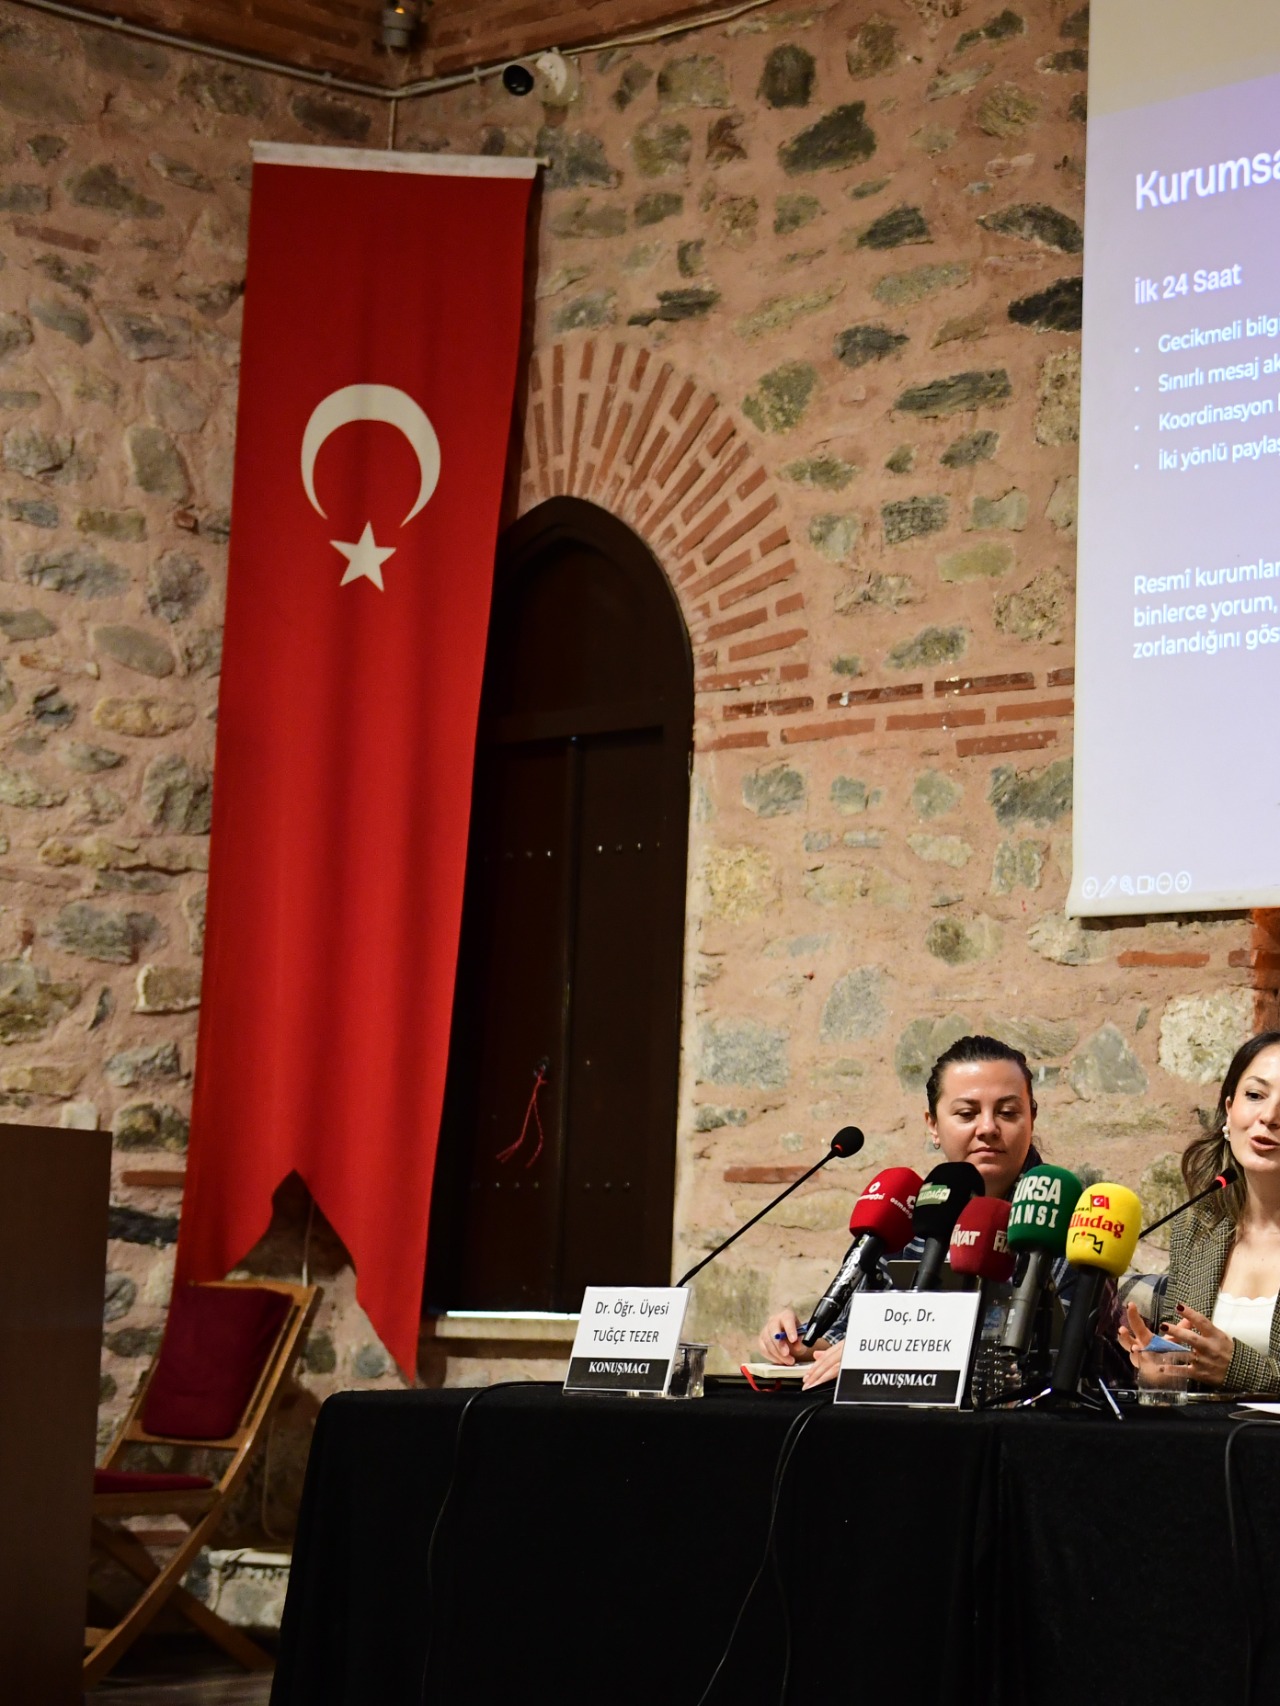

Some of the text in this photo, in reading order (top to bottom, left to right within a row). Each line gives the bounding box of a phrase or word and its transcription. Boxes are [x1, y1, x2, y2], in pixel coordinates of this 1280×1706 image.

[1134, 263, 1243, 304] İlk 24 Saat
[1158, 321, 1242, 353] Gecikmeli
[1158, 366, 1204, 392] Sınırlı
[1208, 356, 1260, 382] mesaj
[1159, 397, 1273, 431] Koordinasyon
[1158, 448, 1178, 470] İki
[1181, 444, 1228, 471] yönlü
[1134, 568, 1192, 596] Resmî
[1134, 600, 1207, 627] binlerce
[1210, 594, 1278, 622] yorum,
[1133, 626, 1241, 659] zorlandığını
[1013, 1175, 1061, 1205] URSA
[595, 1299, 670, 1317] Dr. Öğr. Üyesi
[884, 1308, 935, 1326] Doç. Dr.
[593, 1327, 660, 1344] TUĞÇE TEZER
[859, 1338, 952, 1352] BURCU ZEYBEK
[588, 1361, 650, 1375] KONUŞMACI
[862, 1372, 937, 1388] KONUŞMACI
